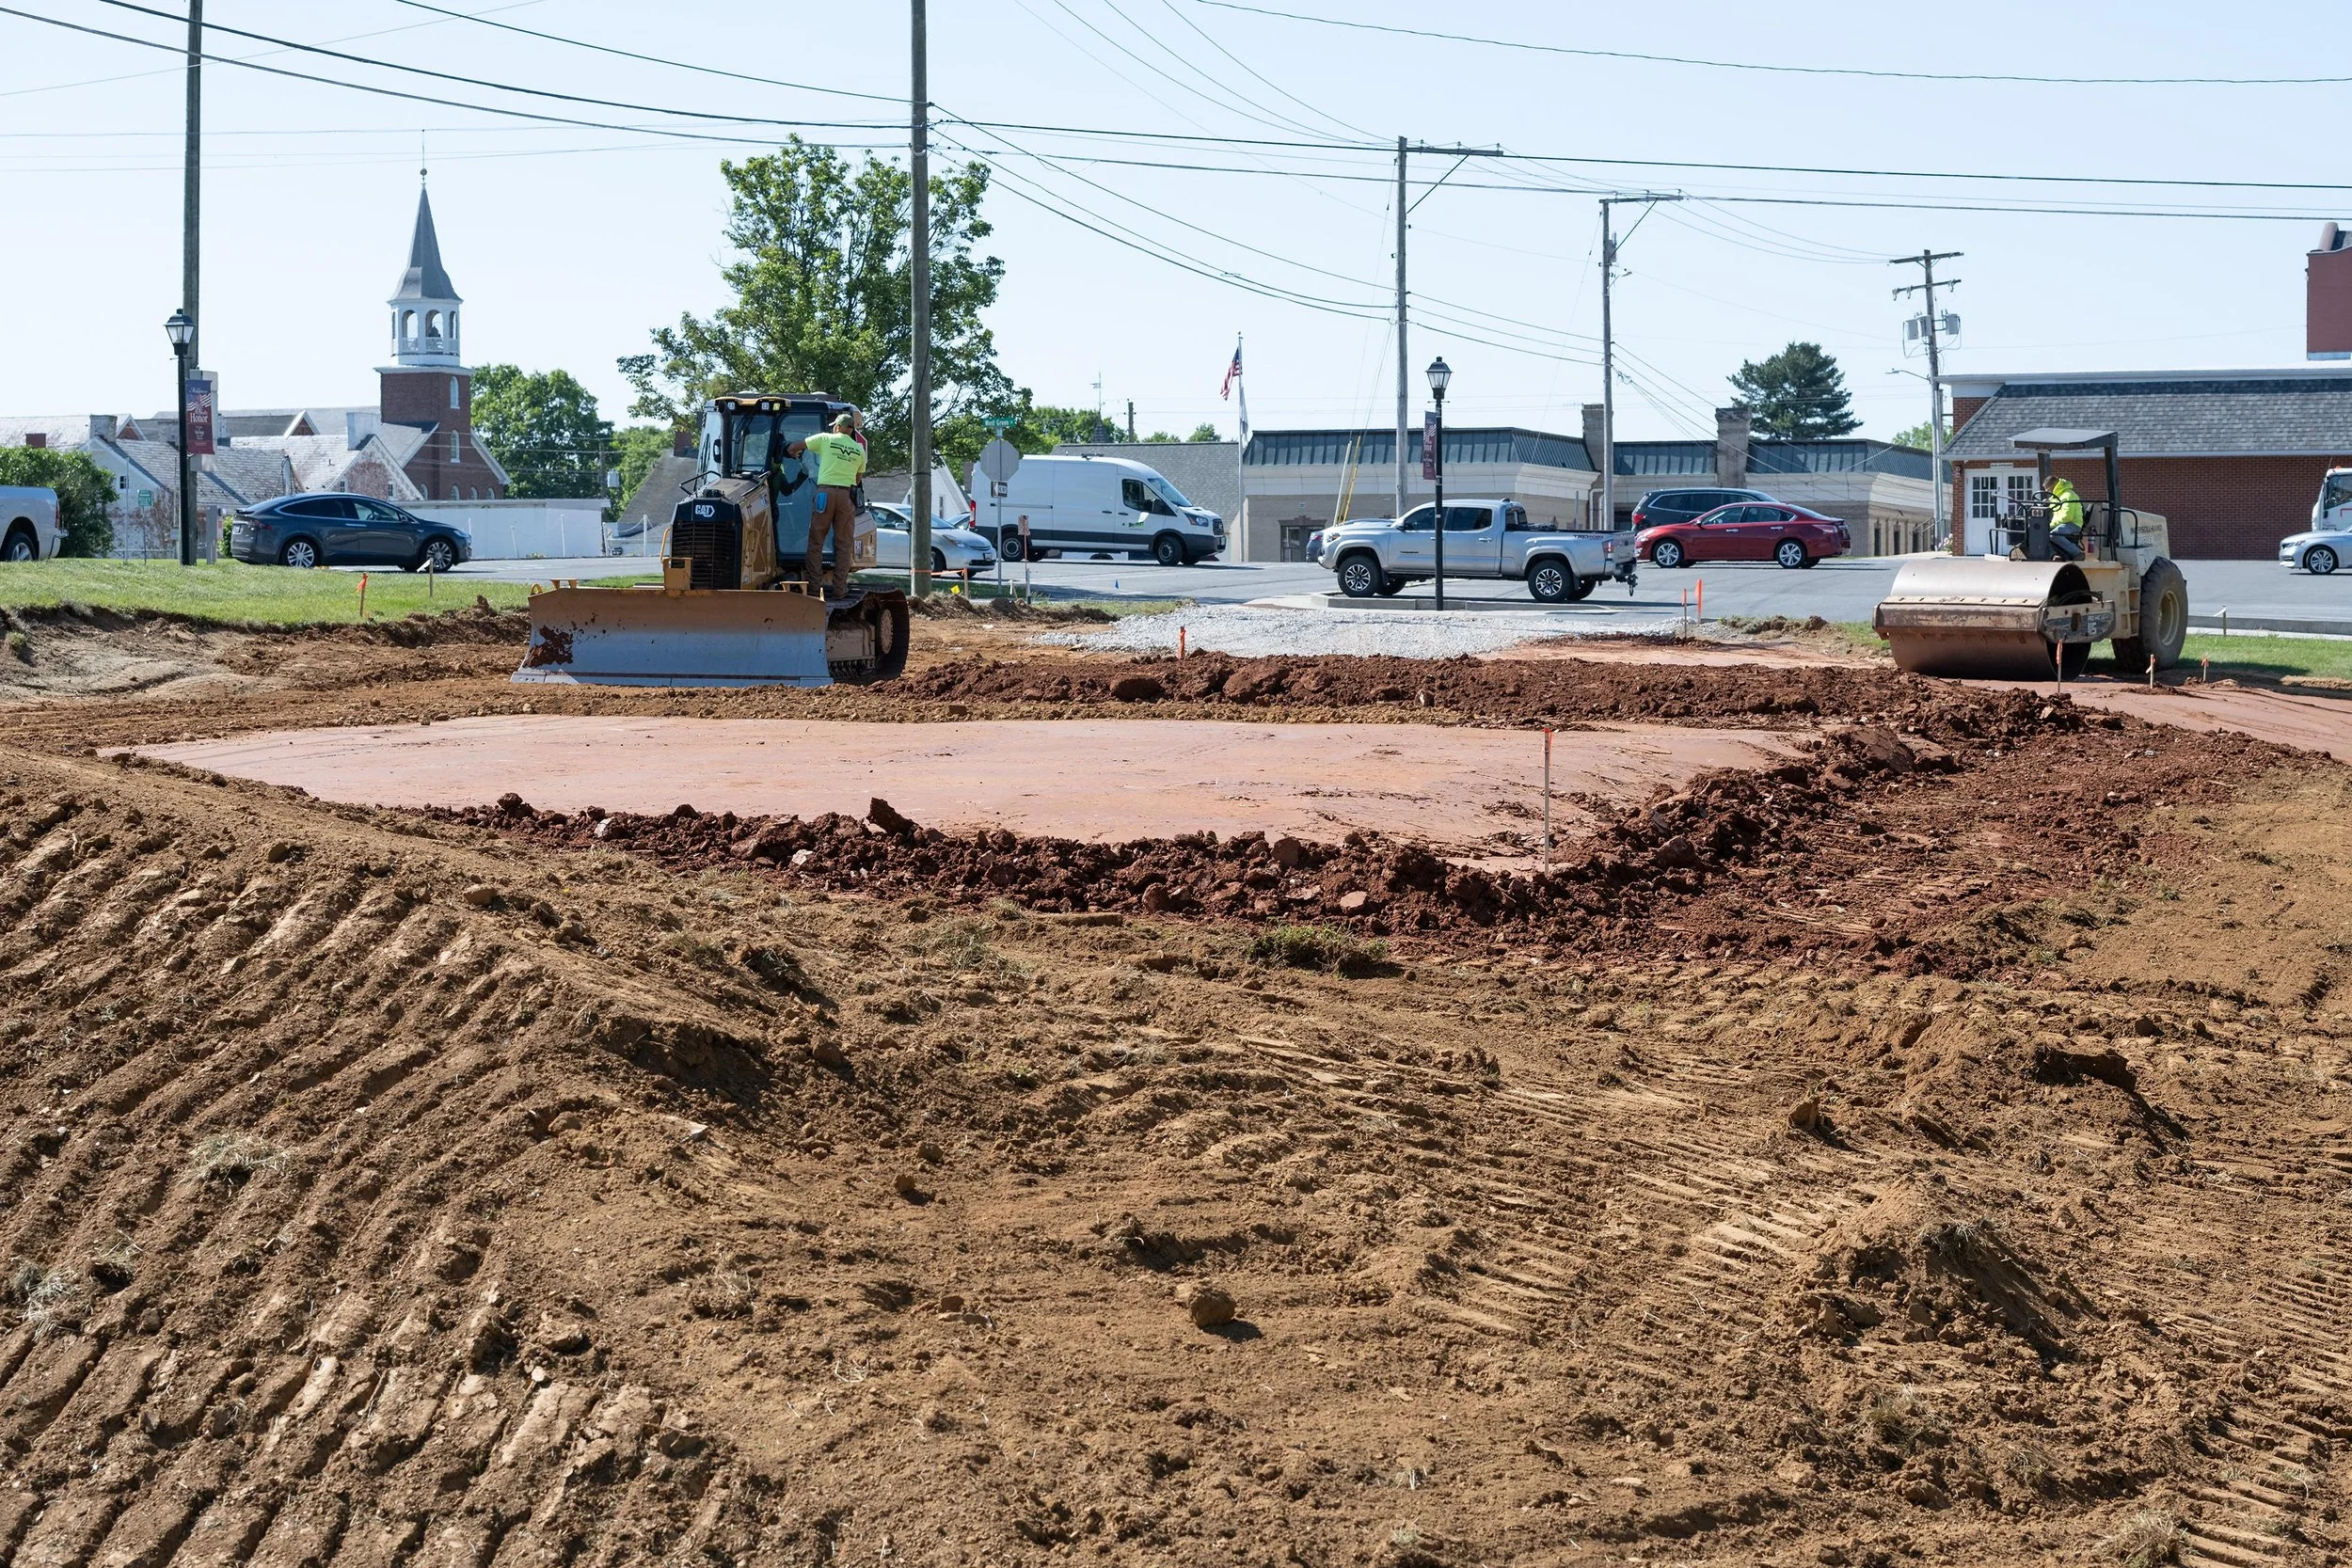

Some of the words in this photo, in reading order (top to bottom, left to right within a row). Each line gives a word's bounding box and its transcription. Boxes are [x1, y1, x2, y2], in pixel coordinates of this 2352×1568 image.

[190, 413, 208, 423] Honor
[695, 504, 713, 515] CAT
[2130, 525, 2163, 534] INERSOLL-RAND
